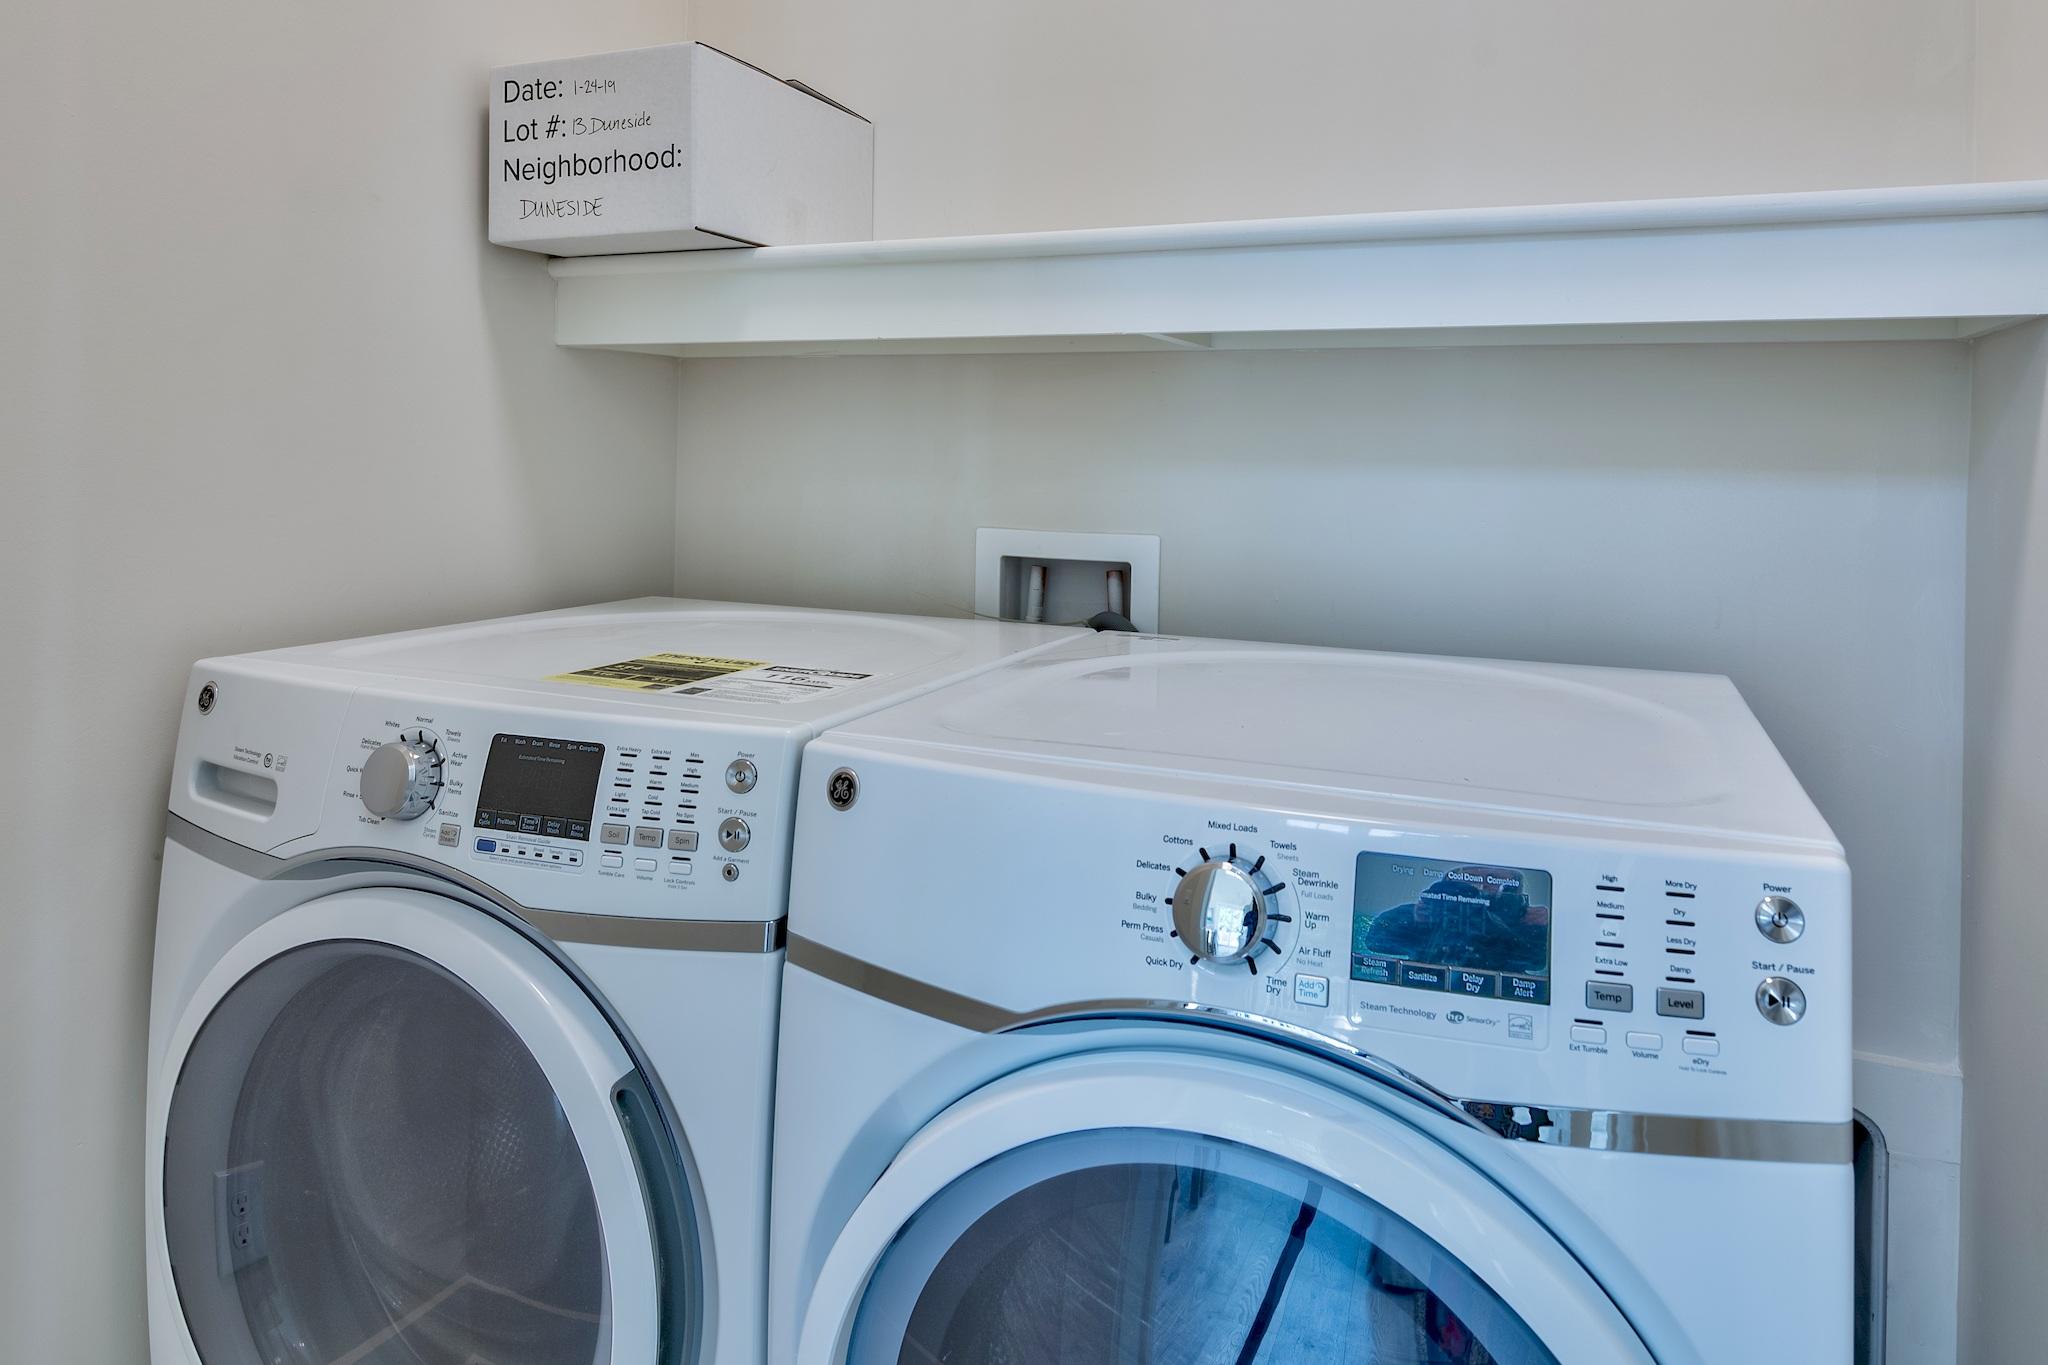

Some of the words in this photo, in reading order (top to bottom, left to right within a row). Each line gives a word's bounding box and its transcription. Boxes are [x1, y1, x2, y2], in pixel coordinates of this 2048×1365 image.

[504, 78, 563, 104] Date:
[573, 79, 616, 95] 1-24-19
[504, 119, 538, 142] Lot
[545, 115, 566, 138] #:
[504, 143, 682, 185] Neighborhood:
[519, 197, 604, 220] DUNESIDE
[385, 720, 400, 728] Whites
[416, 716, 434, 724] Normal
[445, 729, 461, 737] Towels
[361, 738, 381, 746] Delicates
[452, 752, 468, 760] Active
[737, 751, 755, 759] Power
[346, 765, 359, 773] Quick
[449, 779, 463, 788] Bulky
[438, 808, 459, 818] Sanitize
[718, 807, 733, 815] Start
[738, 809, 757, 817] Pause
[1207, 820, 1231, 831] Mixed
[1233, 822, 1258, 833] Loads
[607, 830, 620, 838] Soil
[638, 833, 656, 842] Temp
[675, 837, 690, 846] Spin
[1163, 835, 1193, 846] Cottons
[1270, 840, 1297, 851] Towels
[1276, 852, 1299, 862] Sheets
[1136, 860, 1171, 871] Delicates
[1292, 868, 1320, 879] Steam
[1392, 864, 1414, 875] Drying
[1423, 868, 1444, 879] Damp
[1448, 871, 1463, 881] Cool
[1464, 873, 1483, 883] Down
[1486, 875, 1520, 888] Complete
[1601, 874, 1618, 883] High
[1297, 877, 1339, 890] Dewrinkle
[1665, 879, 1683, 889] More
[1684, 881, 1697, 891] Dry
[1763, 883, 1792, 893] Power
[1135, 891, 1157, 903] Bulky
[1300, 890, 1314, 899] Full
[1315, 892, 1334, 901] Loads
[1442, 893, 1457, 901] Time
[1458, 895, 1490, 906] Remaining
[1596, 900, 1625, 910] Medium
[1304, 911, 1330, 922] Warm
[1673, 908, 1686, 918] Dry
[1121, 920, 1143, 931] Perm
[1144, 922, 1164, 933] Press
[1304, 920, 1317, 930] Up
[1602, 929, 1617, 937] Low
[1666, 936, 1682, 945] Less
[1683, 937, 1696, 946] Dry
[1298, 946, 1312, 956] Air
[1313, 947, 1331, 958] Fluff
[1145, 956, 1167, 966] Quick
[1168, 958, 1184, 969] Dry
[1296, 957, 1307, 965] No
[1307, 958, 1323, 967] Heat
[1363, 957, 1387, 968] Steam
[1595, 956, 1613, 965] Extra
[1614, 958, 1628, 967] Low
[1361, 966, 1388, 977] Refresh
[1669, 964, 1691, 974] Damp
[1752, 961, 1777, 971] Start
[1779, 962, 1785, 972] /
[1786, 963, 1815, 975] Pause
[1266, 976, 1287, 987] Time
[1408, 970, 1437, 983] Sanitize
[1462, 972, 1484, 985] Delay
[1298, 980, 1315, 989] Add
[1466, 982, 1481, 994] Dry
[1512, 978, 1536, 990] Damp
[1265, 984, 1281, 996] Dry
[1298, 988, 1318, 999] Time
[1514, 987, 1534, 998] Alert
[1594, 990, 1622, 1003] Temp
[1667, 998, 1694, 1010] Level
[1360, 1000, 1387, 1012] Steam
[1389, 1005, 1437, 1020] Technology
[1569, 1043, 1581, 1052] Ext
[1581, 1045, 1608, 1055] Tumble
[1631, 1050, 1659, 1060] Volume
[1692, 1057, 1710, 1067] eDry
